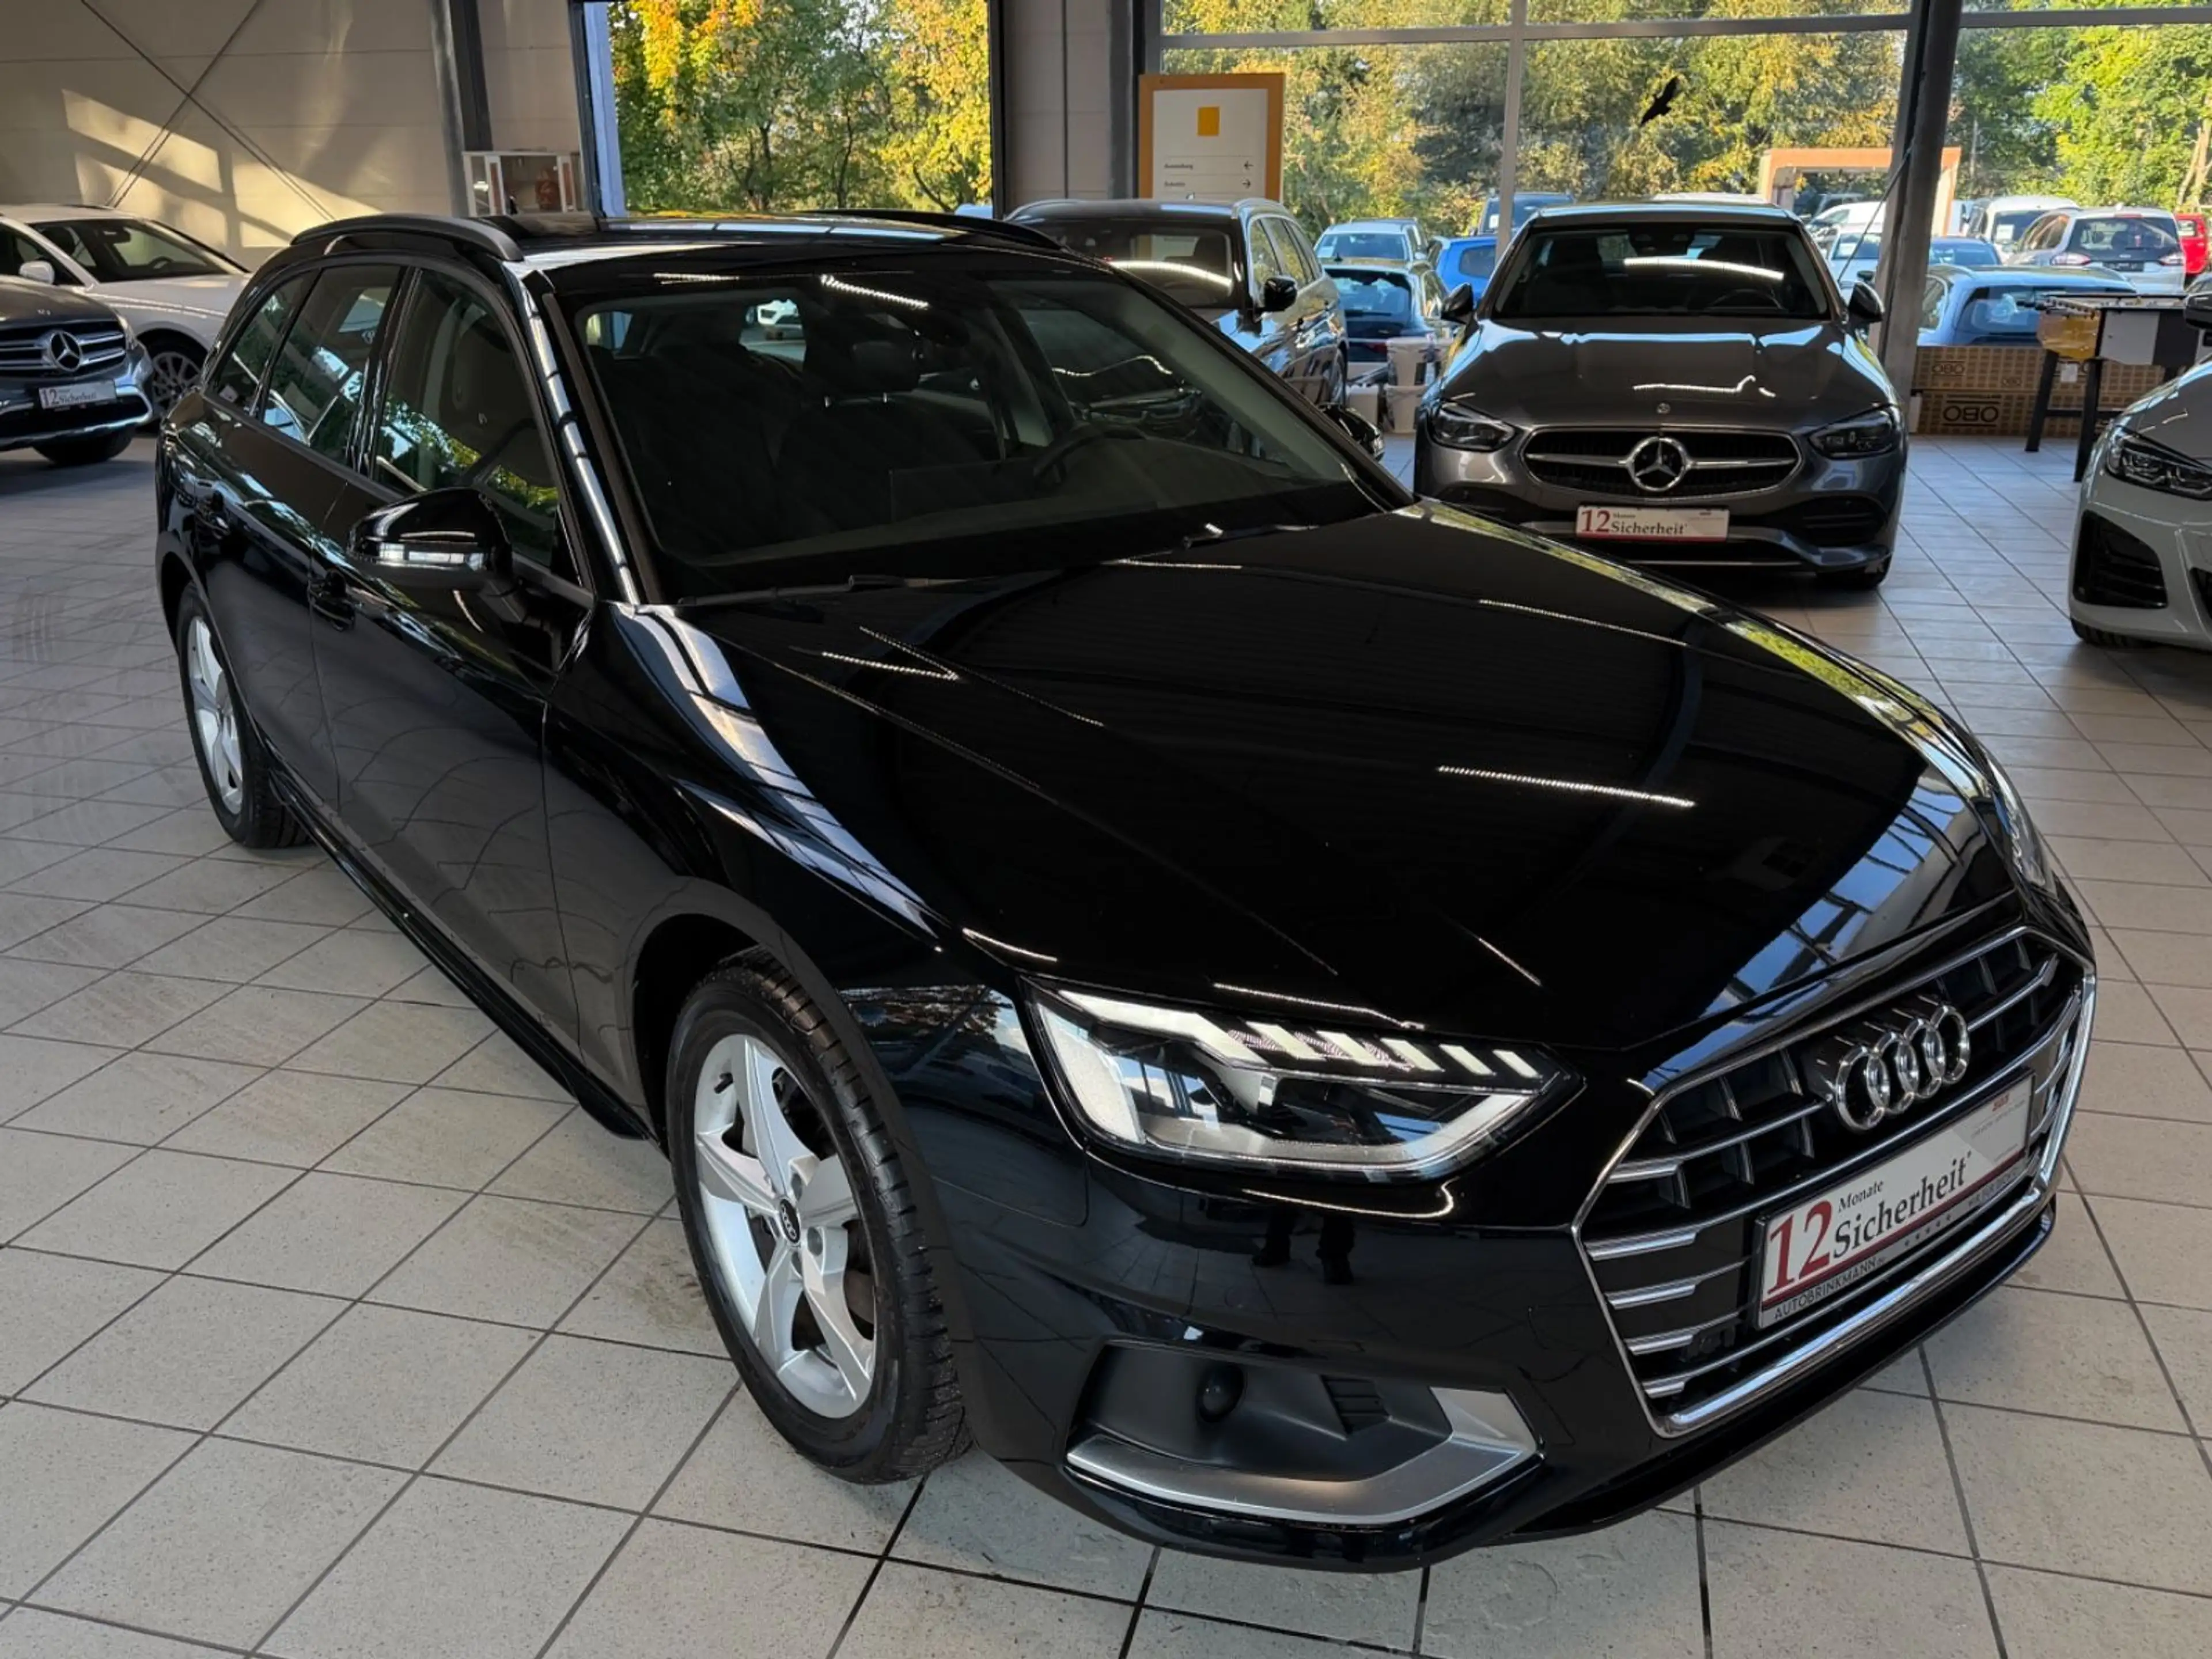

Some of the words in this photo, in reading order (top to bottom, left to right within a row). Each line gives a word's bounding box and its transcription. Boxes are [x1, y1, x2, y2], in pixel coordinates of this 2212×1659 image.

[1943, 406, 1999, 422] OBO
[1581, 509, 1611, 533] 12
[1767, 1200, 1833, 1295] 12
[1838, 1180, 1884, 1213] Monate
